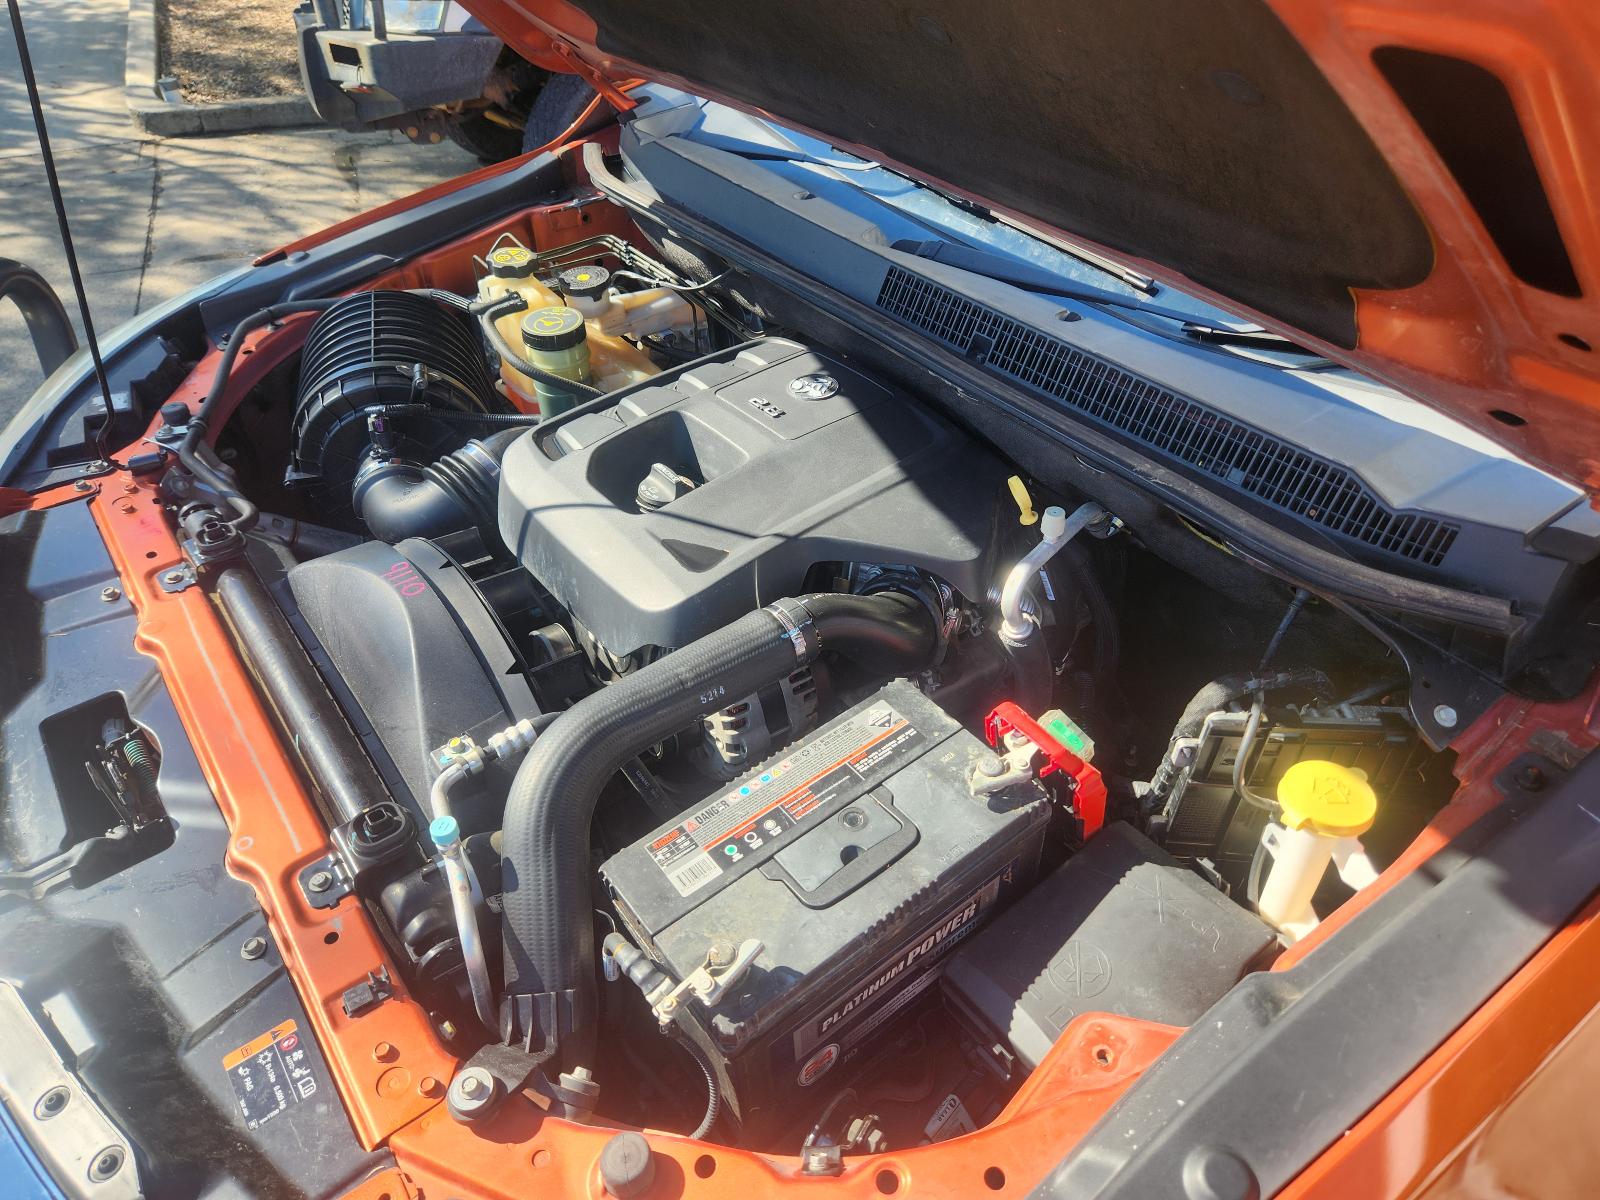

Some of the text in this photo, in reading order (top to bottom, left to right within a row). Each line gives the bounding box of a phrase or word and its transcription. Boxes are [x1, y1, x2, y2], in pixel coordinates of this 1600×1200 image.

[694, 799, 730, 825] DANGER
[821, 960, 905, 1032] PLATINUM
[906, 902, 977, 966] POWER
[244, 1077, 254, 1092] PAG
